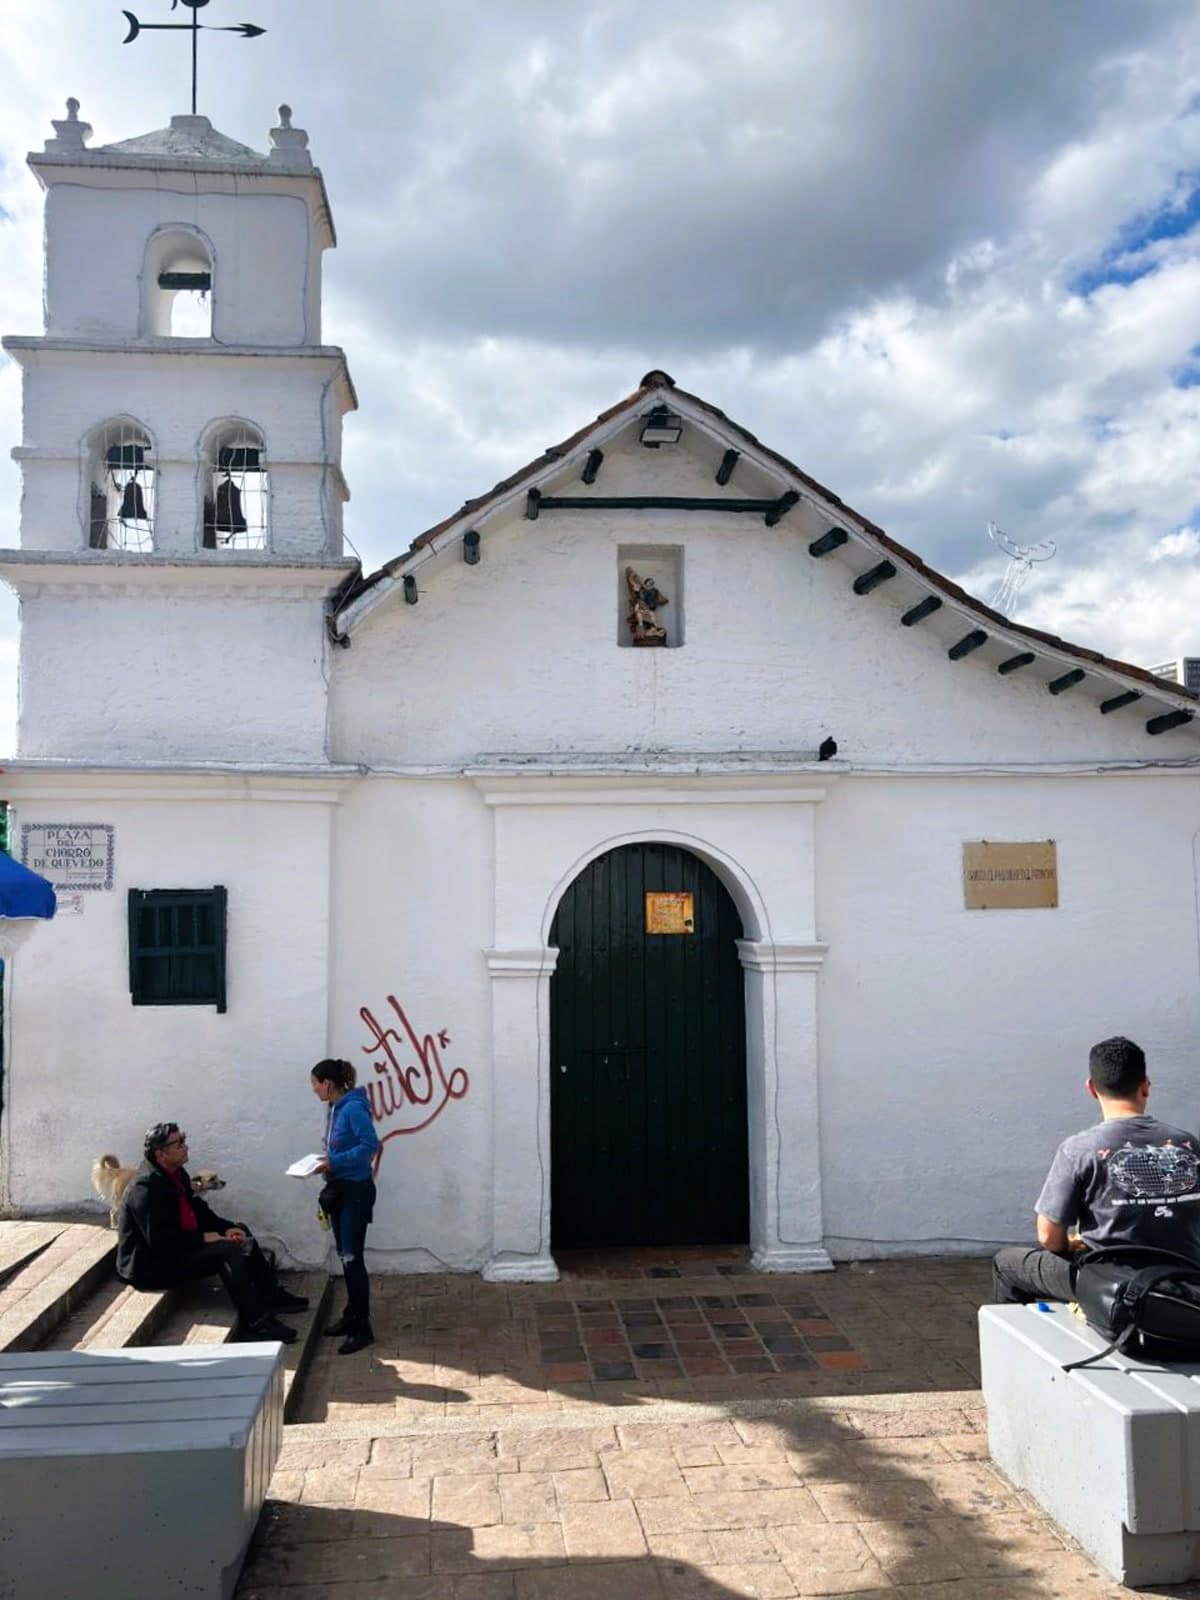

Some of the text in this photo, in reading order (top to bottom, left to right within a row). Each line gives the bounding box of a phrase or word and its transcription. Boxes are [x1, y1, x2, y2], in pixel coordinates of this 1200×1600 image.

[47, 830, 92, 840] PLAZA
[46, 847, 92, 858] CHORRO
[33, 858, 105, 869] DE QUEVEDO
